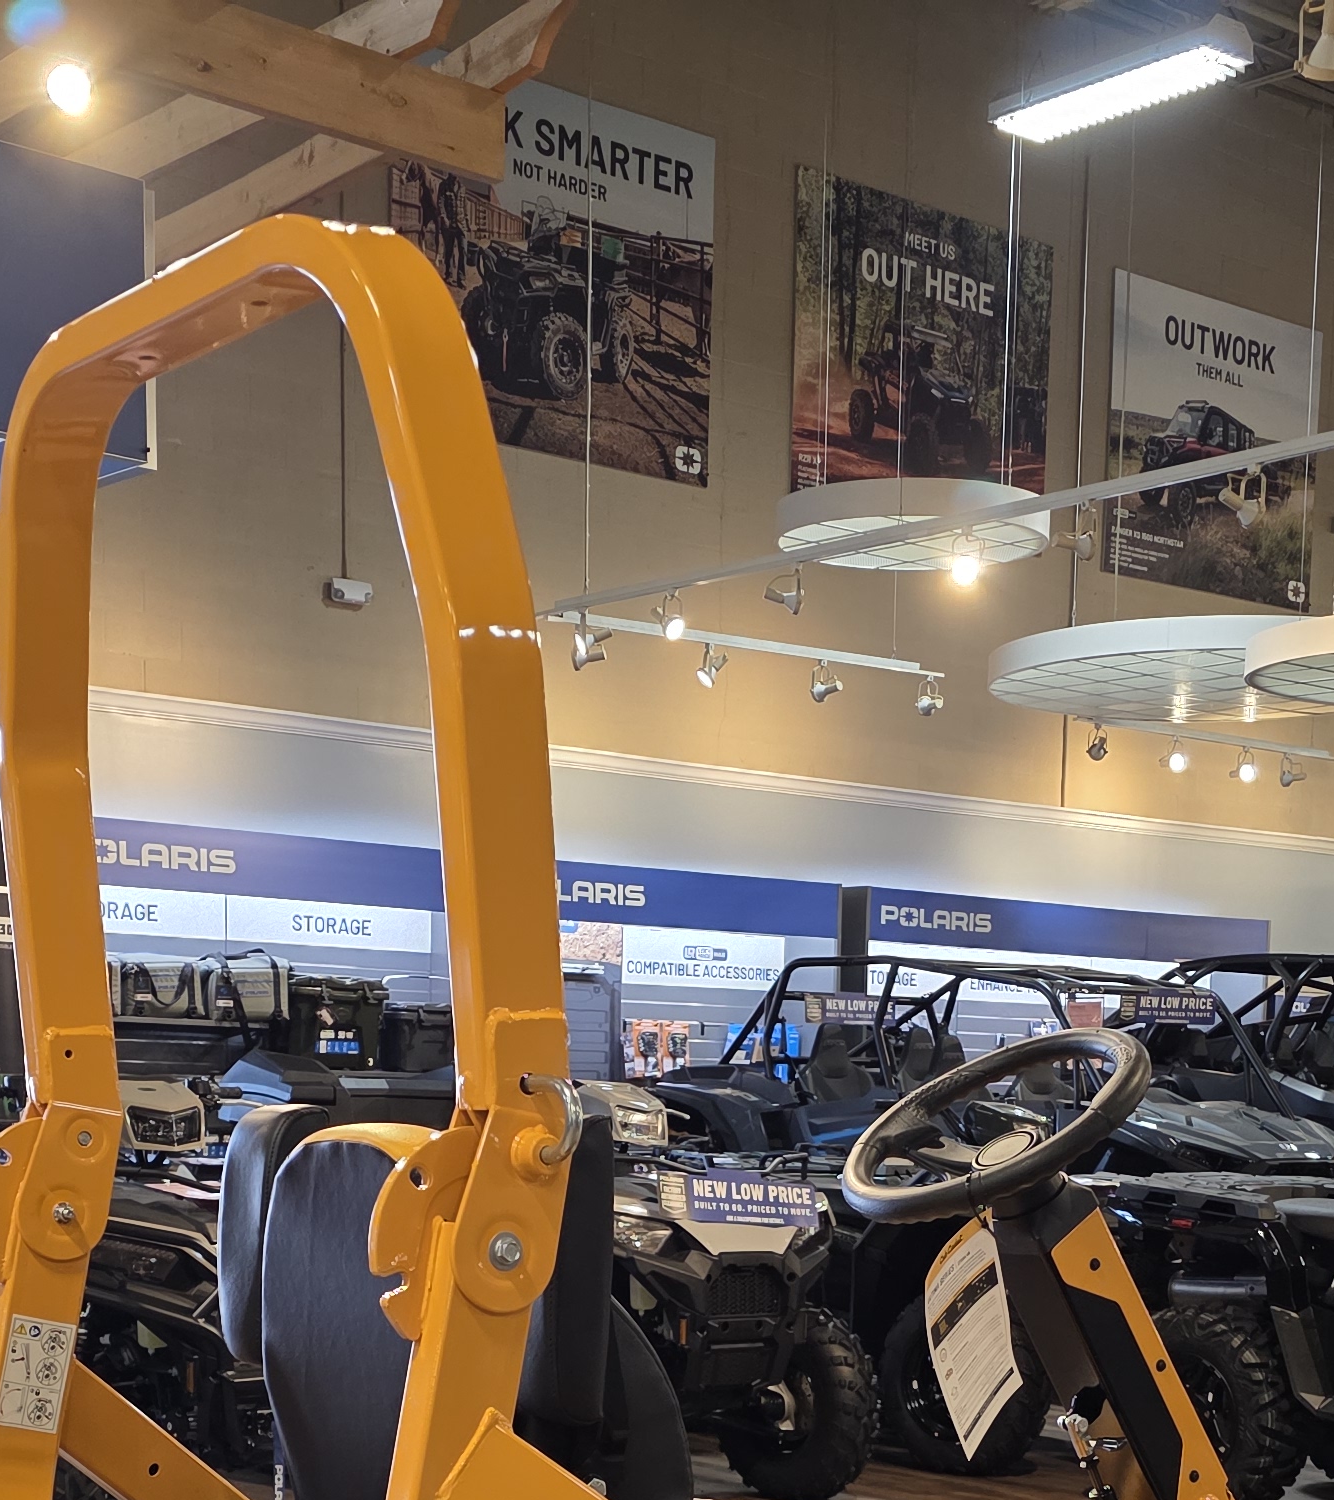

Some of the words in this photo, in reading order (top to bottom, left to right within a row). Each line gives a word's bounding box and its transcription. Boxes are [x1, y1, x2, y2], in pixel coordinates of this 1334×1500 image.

[534, 118, 694, 200] SMARTER
[513, 158, 544, 182] NOT
[547, 170, 608, 203] HARDER
[904, 231, 938, 255] MEET
[939, 242, 956, 260] US
[861, 247, 918, 293] OUT
[925, 264, 995, 317] HERE
[1164, 315, 1276, 375] OUTWORK
[1195, 362, 1223, 383] THEM
[1224, 371, 1244, 388] ALL
[291, 914, 372, 937] STORAGE
[880, 904, 993, 933] POLARIS
[626, 960, 701, 978] COMPATIBLE
[702, 963, 780, 982] ACCESSORIES
[869, 970, 917, 987] TOAGE
[825, 998, 846, 1010] NEW
[847, 999, 867, 1012] LOW
[867, 1000, 894, 1013] PRE
[1139, 995, 1160, 1009] NEW
[1160, 996, 1180, 1010] LOW
[1181, 997, 1214, 1011] PRICE
[692, 1178, 728, 1199] NEW
[731, 1182, 765, 1202] LOW
[767, 1185, 813, 1205] PRICE
[694, 1200, 717, 1211] BUILT
[718, 1202, 730, 1211] TO
[747, 1205, 777, 1214] PRICED
[777, 1206, 789, 1215] TO
[790, 1207, 814, 1217] MOVE.
